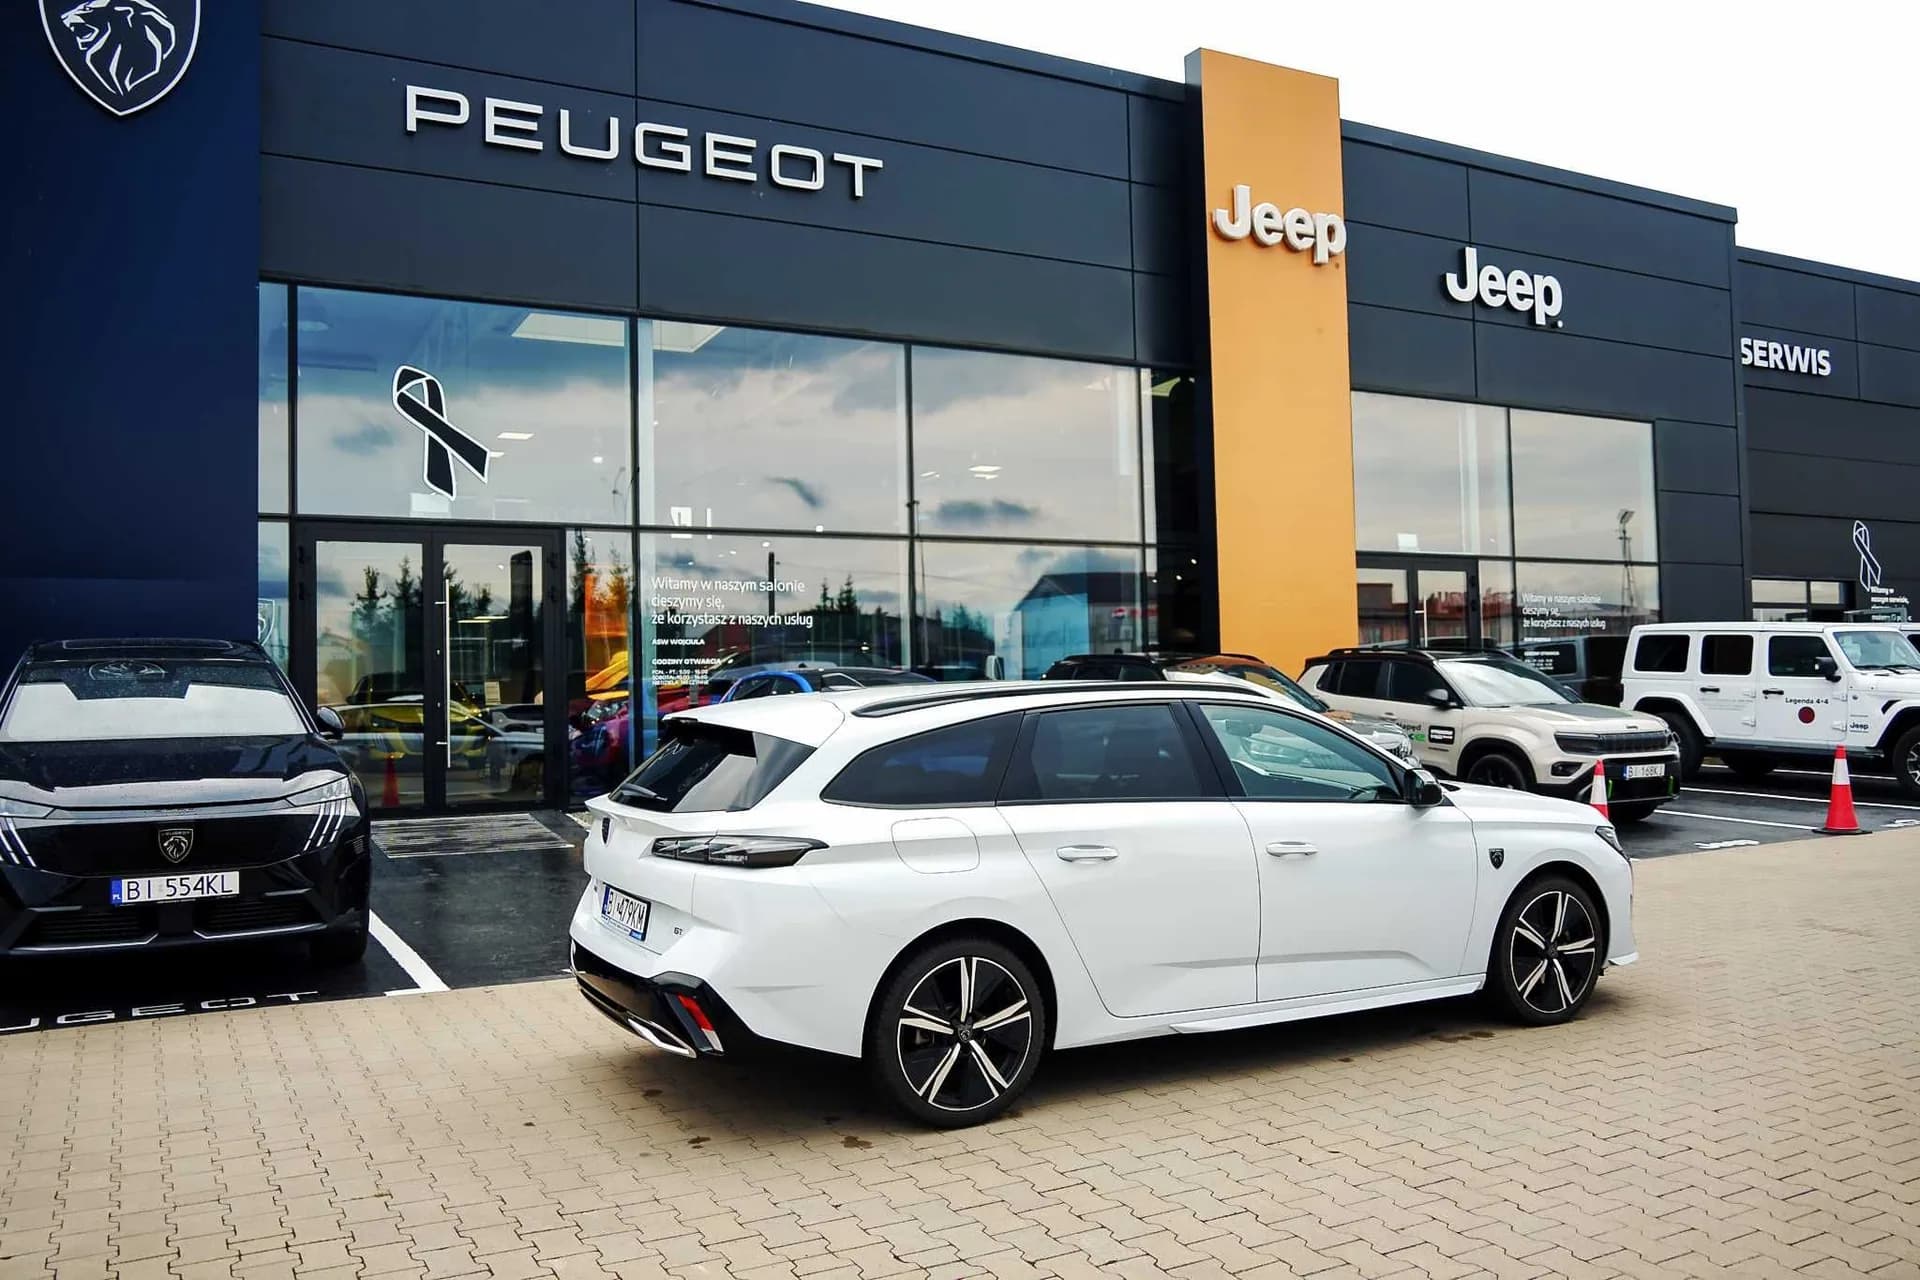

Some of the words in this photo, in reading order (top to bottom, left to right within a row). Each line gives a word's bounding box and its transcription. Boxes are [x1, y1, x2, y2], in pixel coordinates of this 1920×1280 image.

[406, 84, 884, 198] PEUGEOT
[1212, 184, 1347, 265] Jeep
[1445, 246, 1563, 326] Jeep
[1740, 337, 1832, 376] SERWIS
[651, 576, 698, 592] Witamy
[700, 580, 712, 591] w
[714, 580, 757, 593] naszym
[759, 578, 806, 592] salonie
[651, 594, 703, 609] cieszymy
[667, 611, 727, 628] korzystasz
[728, 616, 736, 625] z
[738, 612, 782, 628] naszych
[784, 613, 814, 629] usług
[127, 879, 152, 901] BI
[165, 874, 234, 898] 554KL
